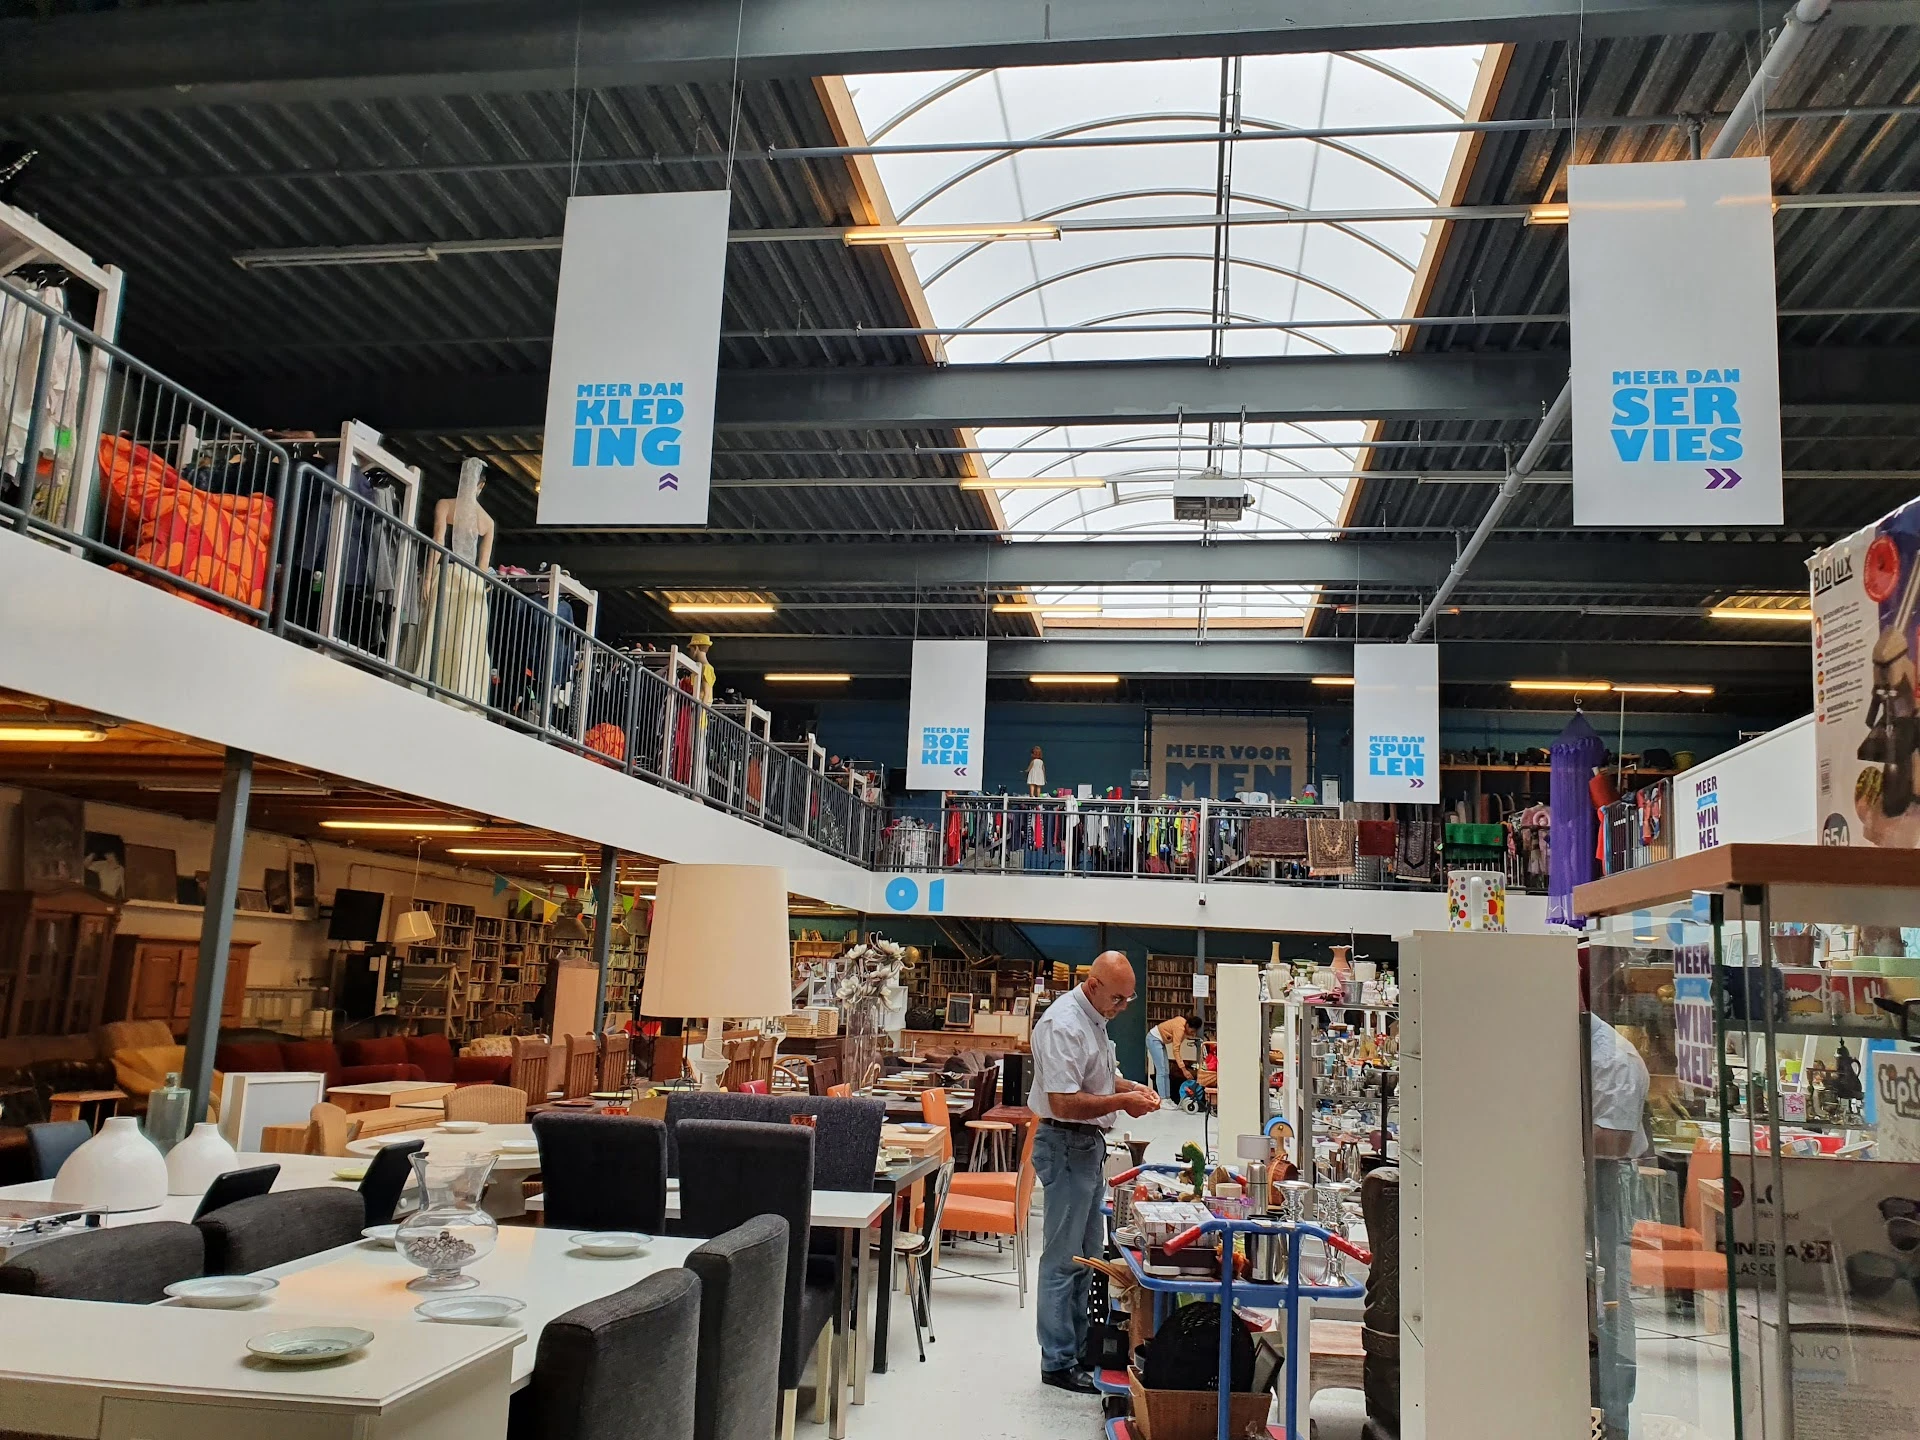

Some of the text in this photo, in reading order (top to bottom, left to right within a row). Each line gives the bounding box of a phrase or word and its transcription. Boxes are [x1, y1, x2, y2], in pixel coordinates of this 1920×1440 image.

[1612, 369, 1740, 385] MEER DAN
[577, 383, 684, 397] MEER DAN
[575, 399, 684, 426] KLED
[1611, 387, 1741, 426] SER
[572, 427, 682, 467] ING
[1610, 427, 1743, 462] VIES
[923, 734, 969, 749] BOE
[1369, 735, 1398, 743] MEER
[1369, 743, 1425, 757] SPUL
[921, 750, 968, 765] KEN
[1166, 743, 1292, 761] MEER VOOR
[1369, 757, 1424, 776] LEN
[1166, 762, 1292, 802] MEN
[1695, 776, 1718, 797] MEER
[1697, 805, 1719, 830] WIN
[1698, 827, 1719, 850] KEL
[885, 877, 944, 911] 01
[1675, 945, 1711, 975] MEER
[1676, 1004, 1712, 1047] WIN
[1678, 1043, 1713, 1088] KEL
[1879, 1064, 1920, 1117] tipt
